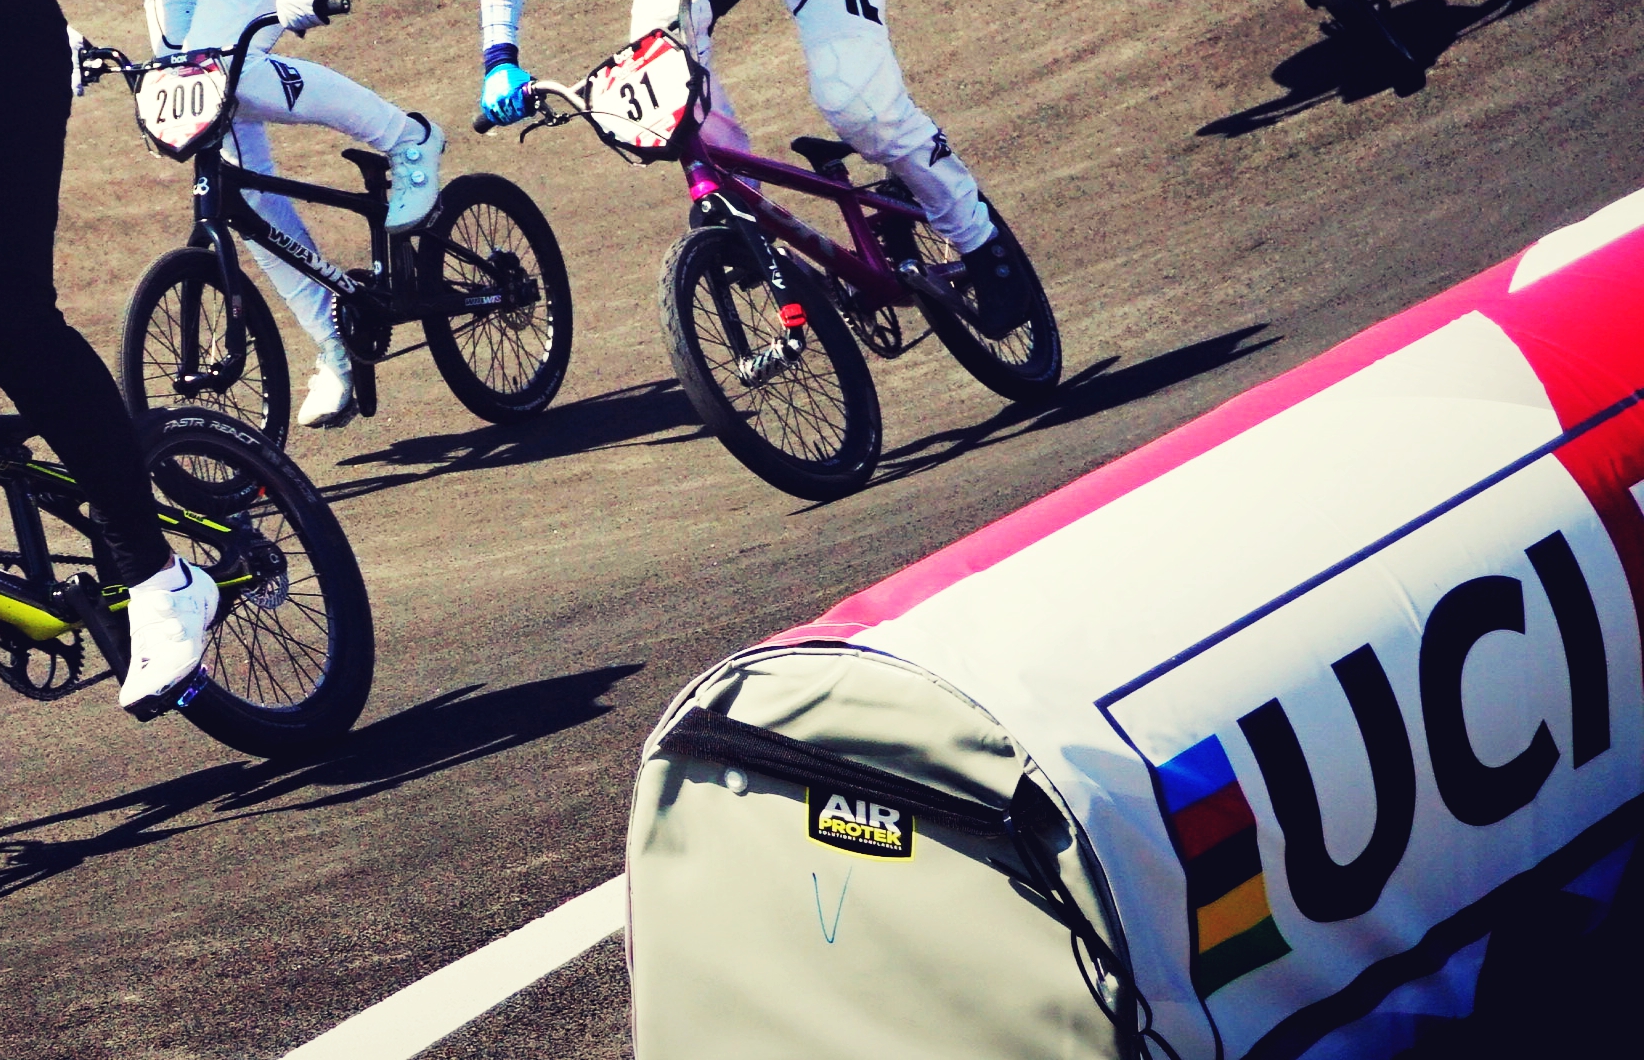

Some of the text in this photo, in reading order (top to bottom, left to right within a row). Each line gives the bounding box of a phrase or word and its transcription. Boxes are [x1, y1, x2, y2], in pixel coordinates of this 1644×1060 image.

[170, 53, 188, 64] box
[156, 80, 204, 124] 200
[619, 71, 659, 122] 31
[267, 226, 360, 295] WIAWIS
[163, 417, 261, 445] FASTR REACT
[1238, 529, 1611, 923] UCI
[819, 793, 902, 834] AIR
[819, 817, 902, 846] PROTEK
[818, 829, 856, 842] SOLUTIONS
